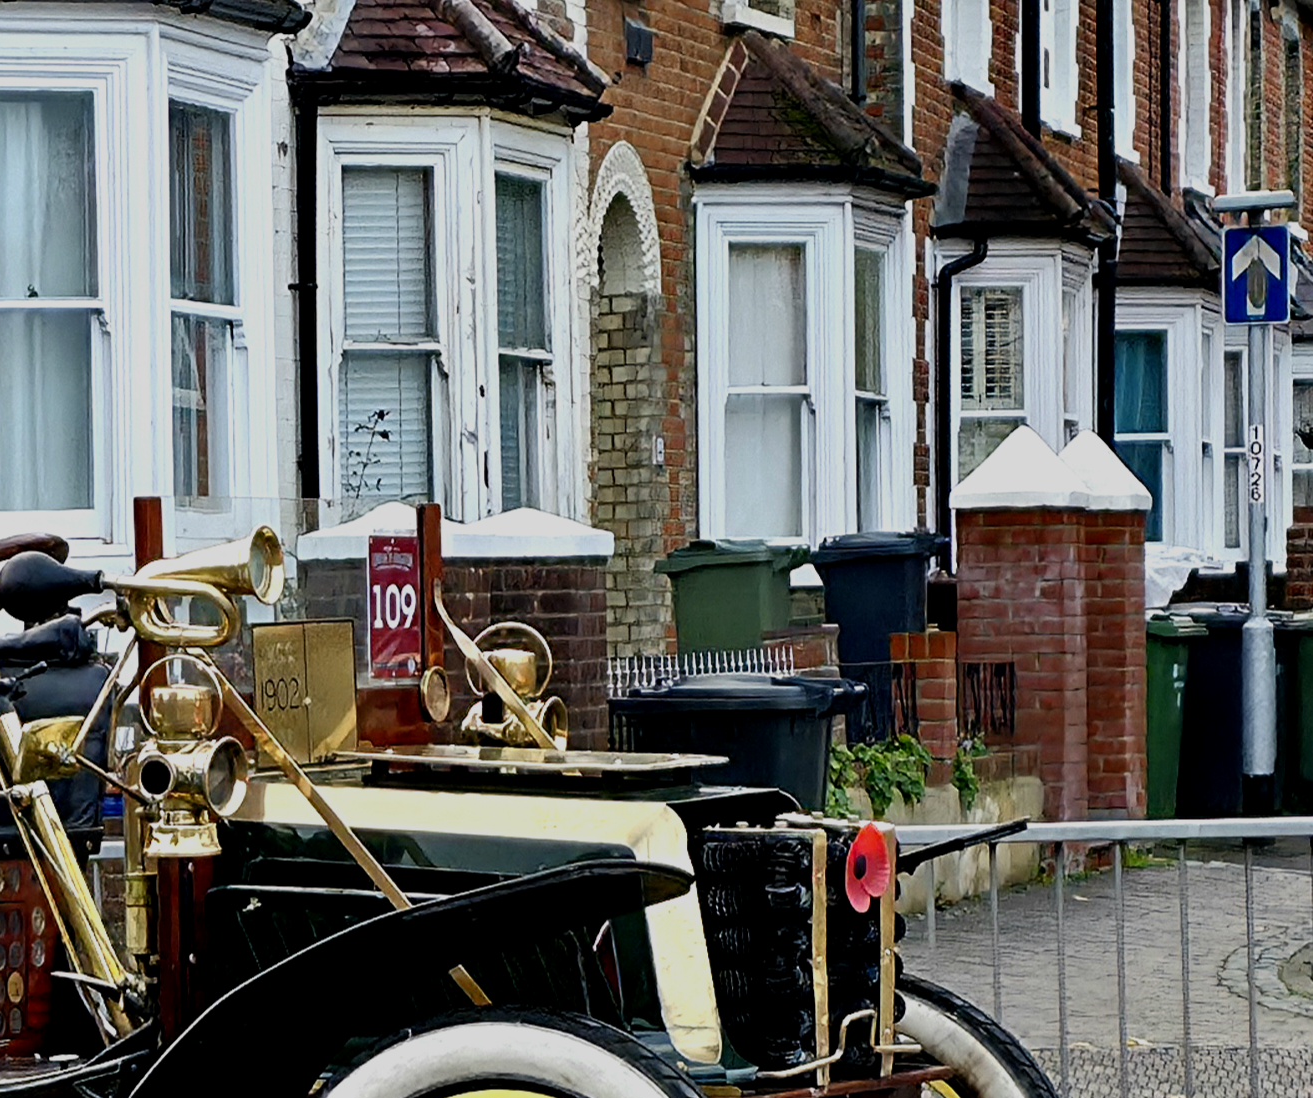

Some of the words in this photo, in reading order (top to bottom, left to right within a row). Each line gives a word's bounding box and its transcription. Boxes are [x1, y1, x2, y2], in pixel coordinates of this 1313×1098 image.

[1250, 424, 1263, 502] 10726
[372, 583, 417, 630] 109
[260, 676, 301, 712] 1902
